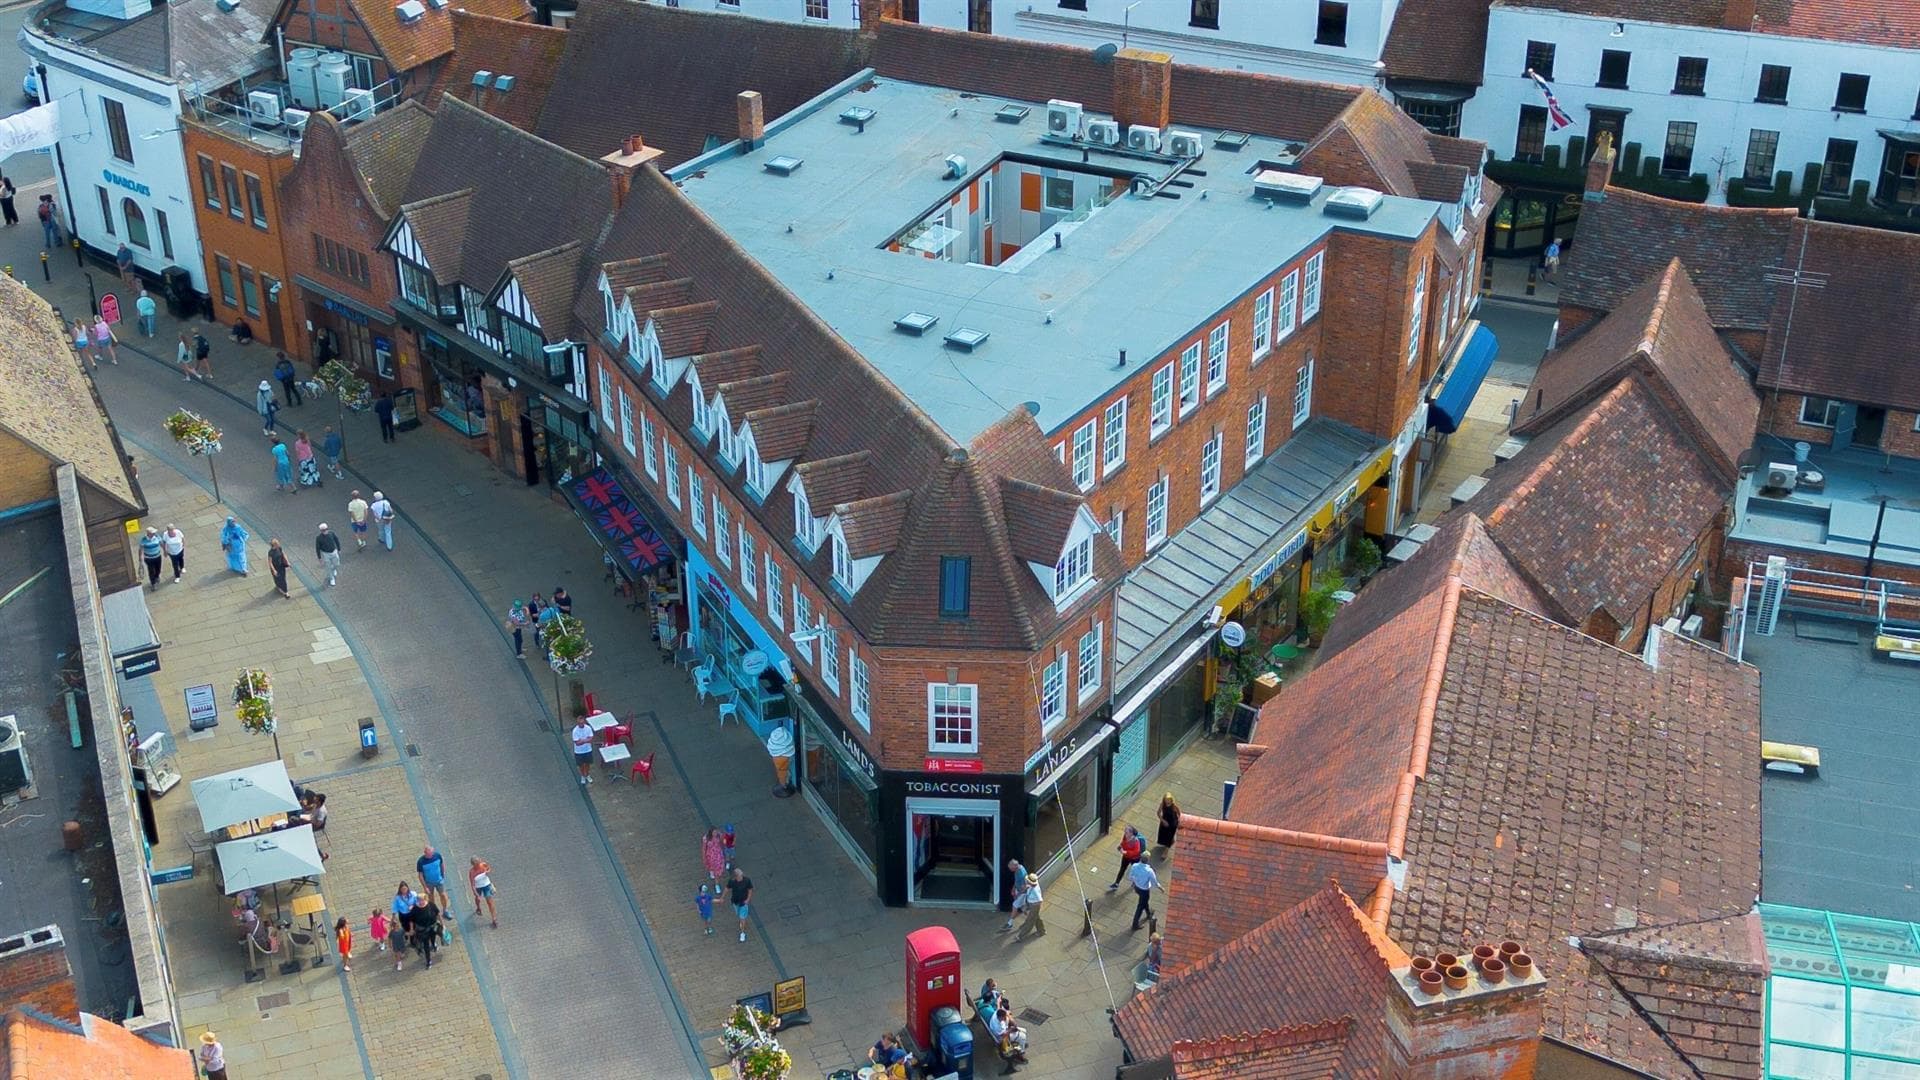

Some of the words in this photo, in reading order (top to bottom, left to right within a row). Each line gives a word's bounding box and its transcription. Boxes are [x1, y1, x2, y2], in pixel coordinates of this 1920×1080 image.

[112, 173, 151, 197] BARCLAYS
[842, 730, 874, 777] LANDS
[1035, 737, 1076, 783] LANDS
[905, 781, 1001, 794] TOBACCONIST
